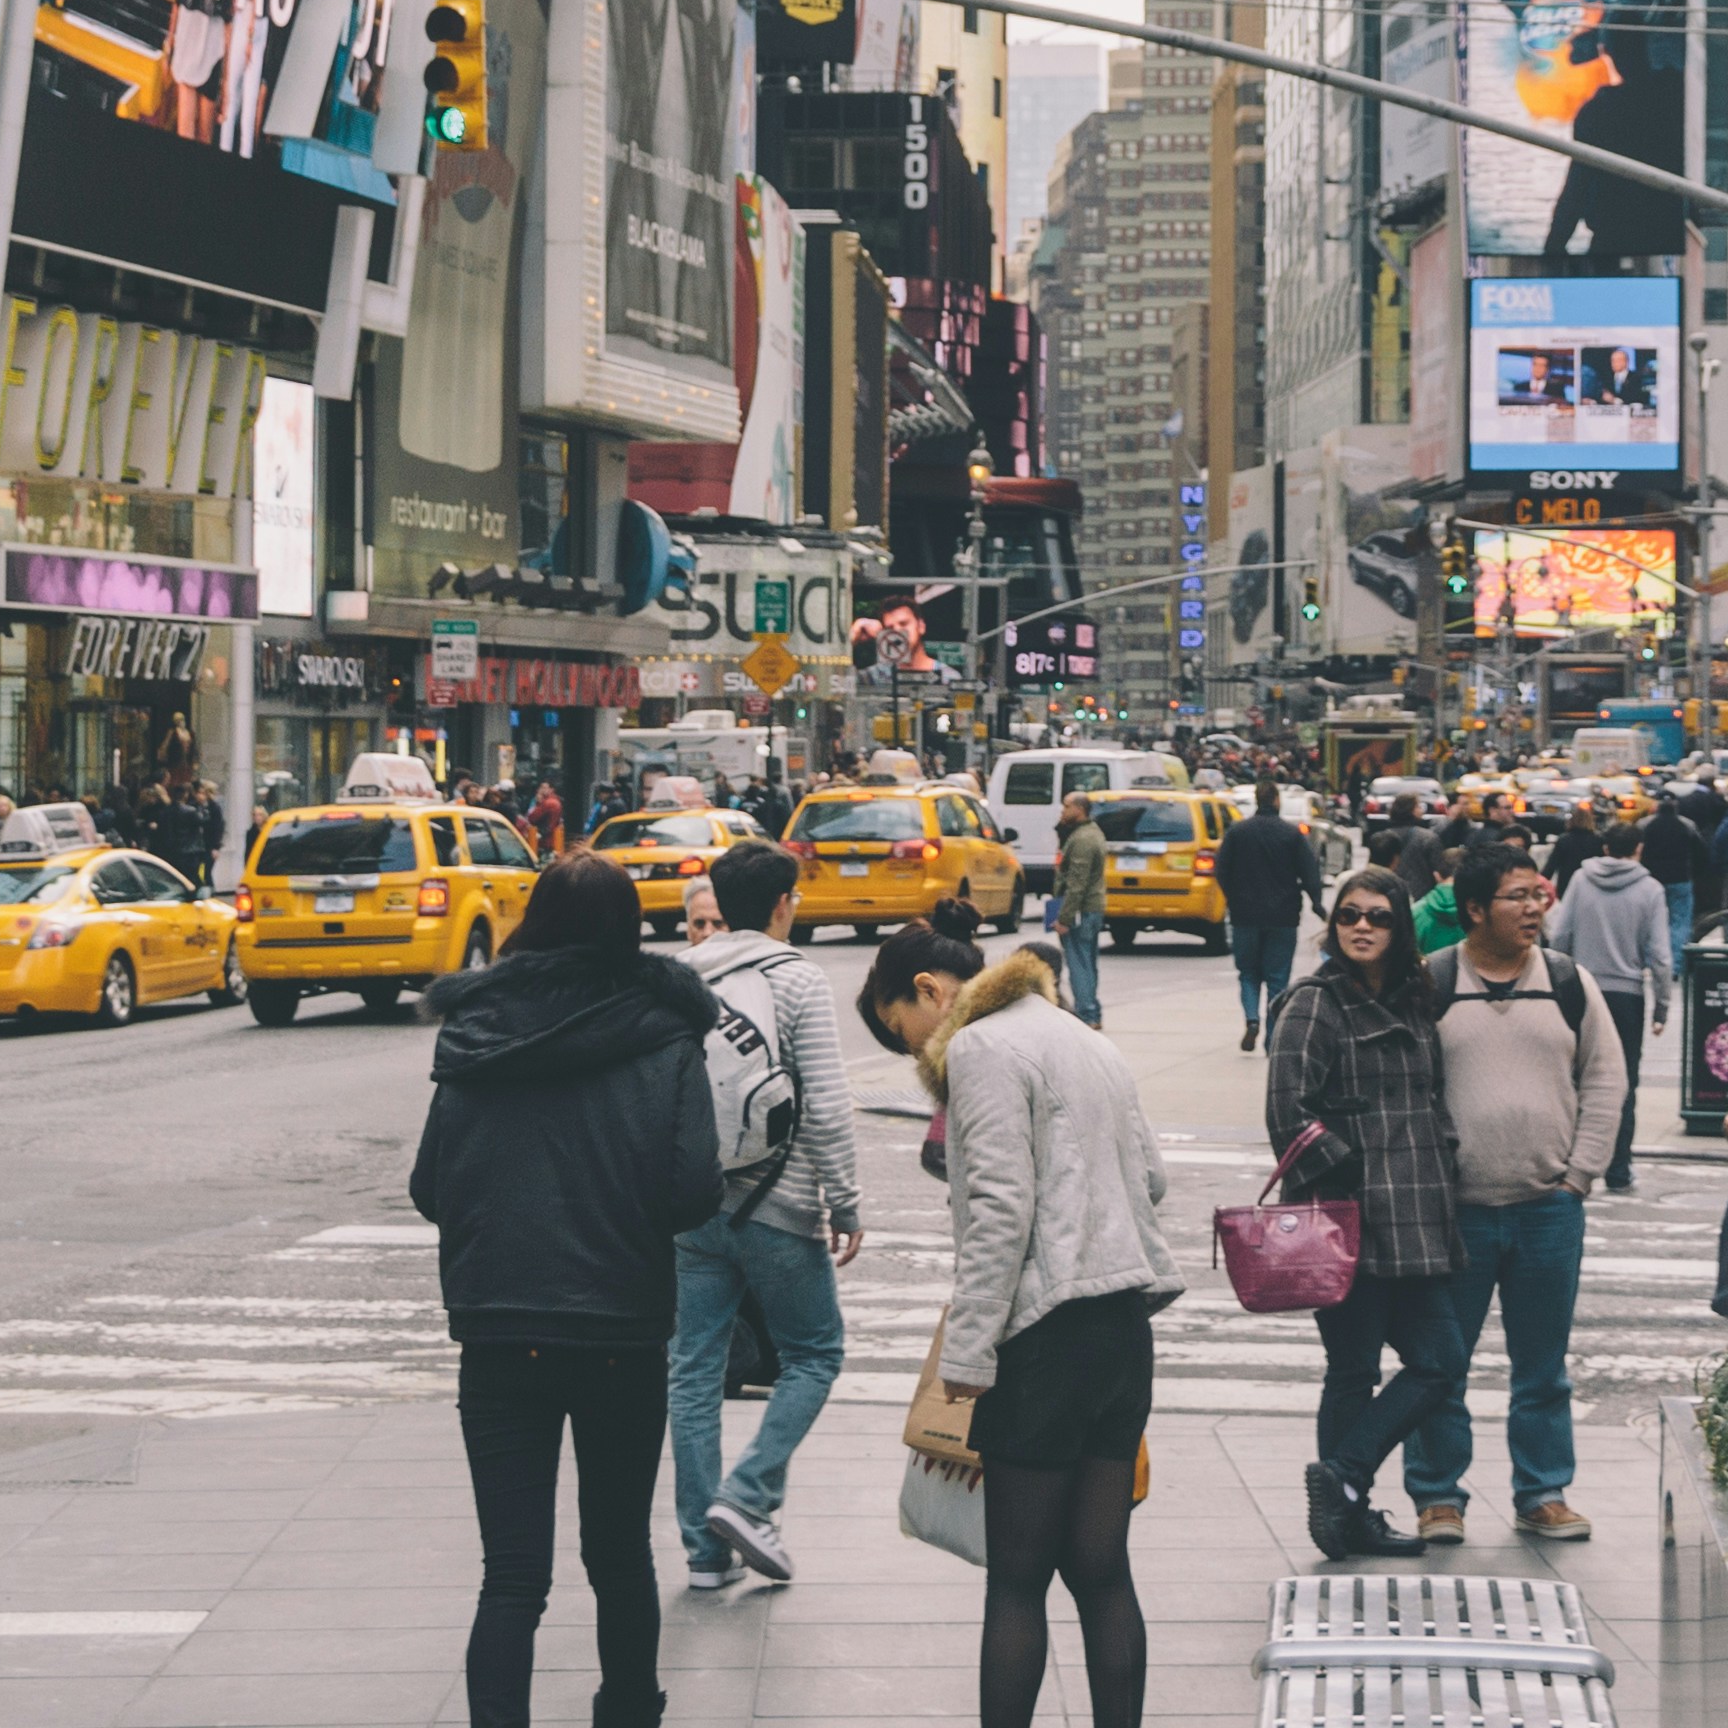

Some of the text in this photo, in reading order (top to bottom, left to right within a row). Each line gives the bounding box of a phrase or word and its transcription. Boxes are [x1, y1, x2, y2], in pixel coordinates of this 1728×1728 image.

[903, 95, 928, 211] 1500
[1479, 285, 1552, 309] FOX
[1529, 471, 1620, 490] SONY
[390, 491, 468, 534] restaurant
[481, 508, 507, 541] bar
[1516, 498, 1601, 526] C MELO
[66, 617, 211, 682] FOREVER 21
[298, 654, 366, 687] SWAROVSKI
[515, 658, 642, 708] HOLLYWOOD
